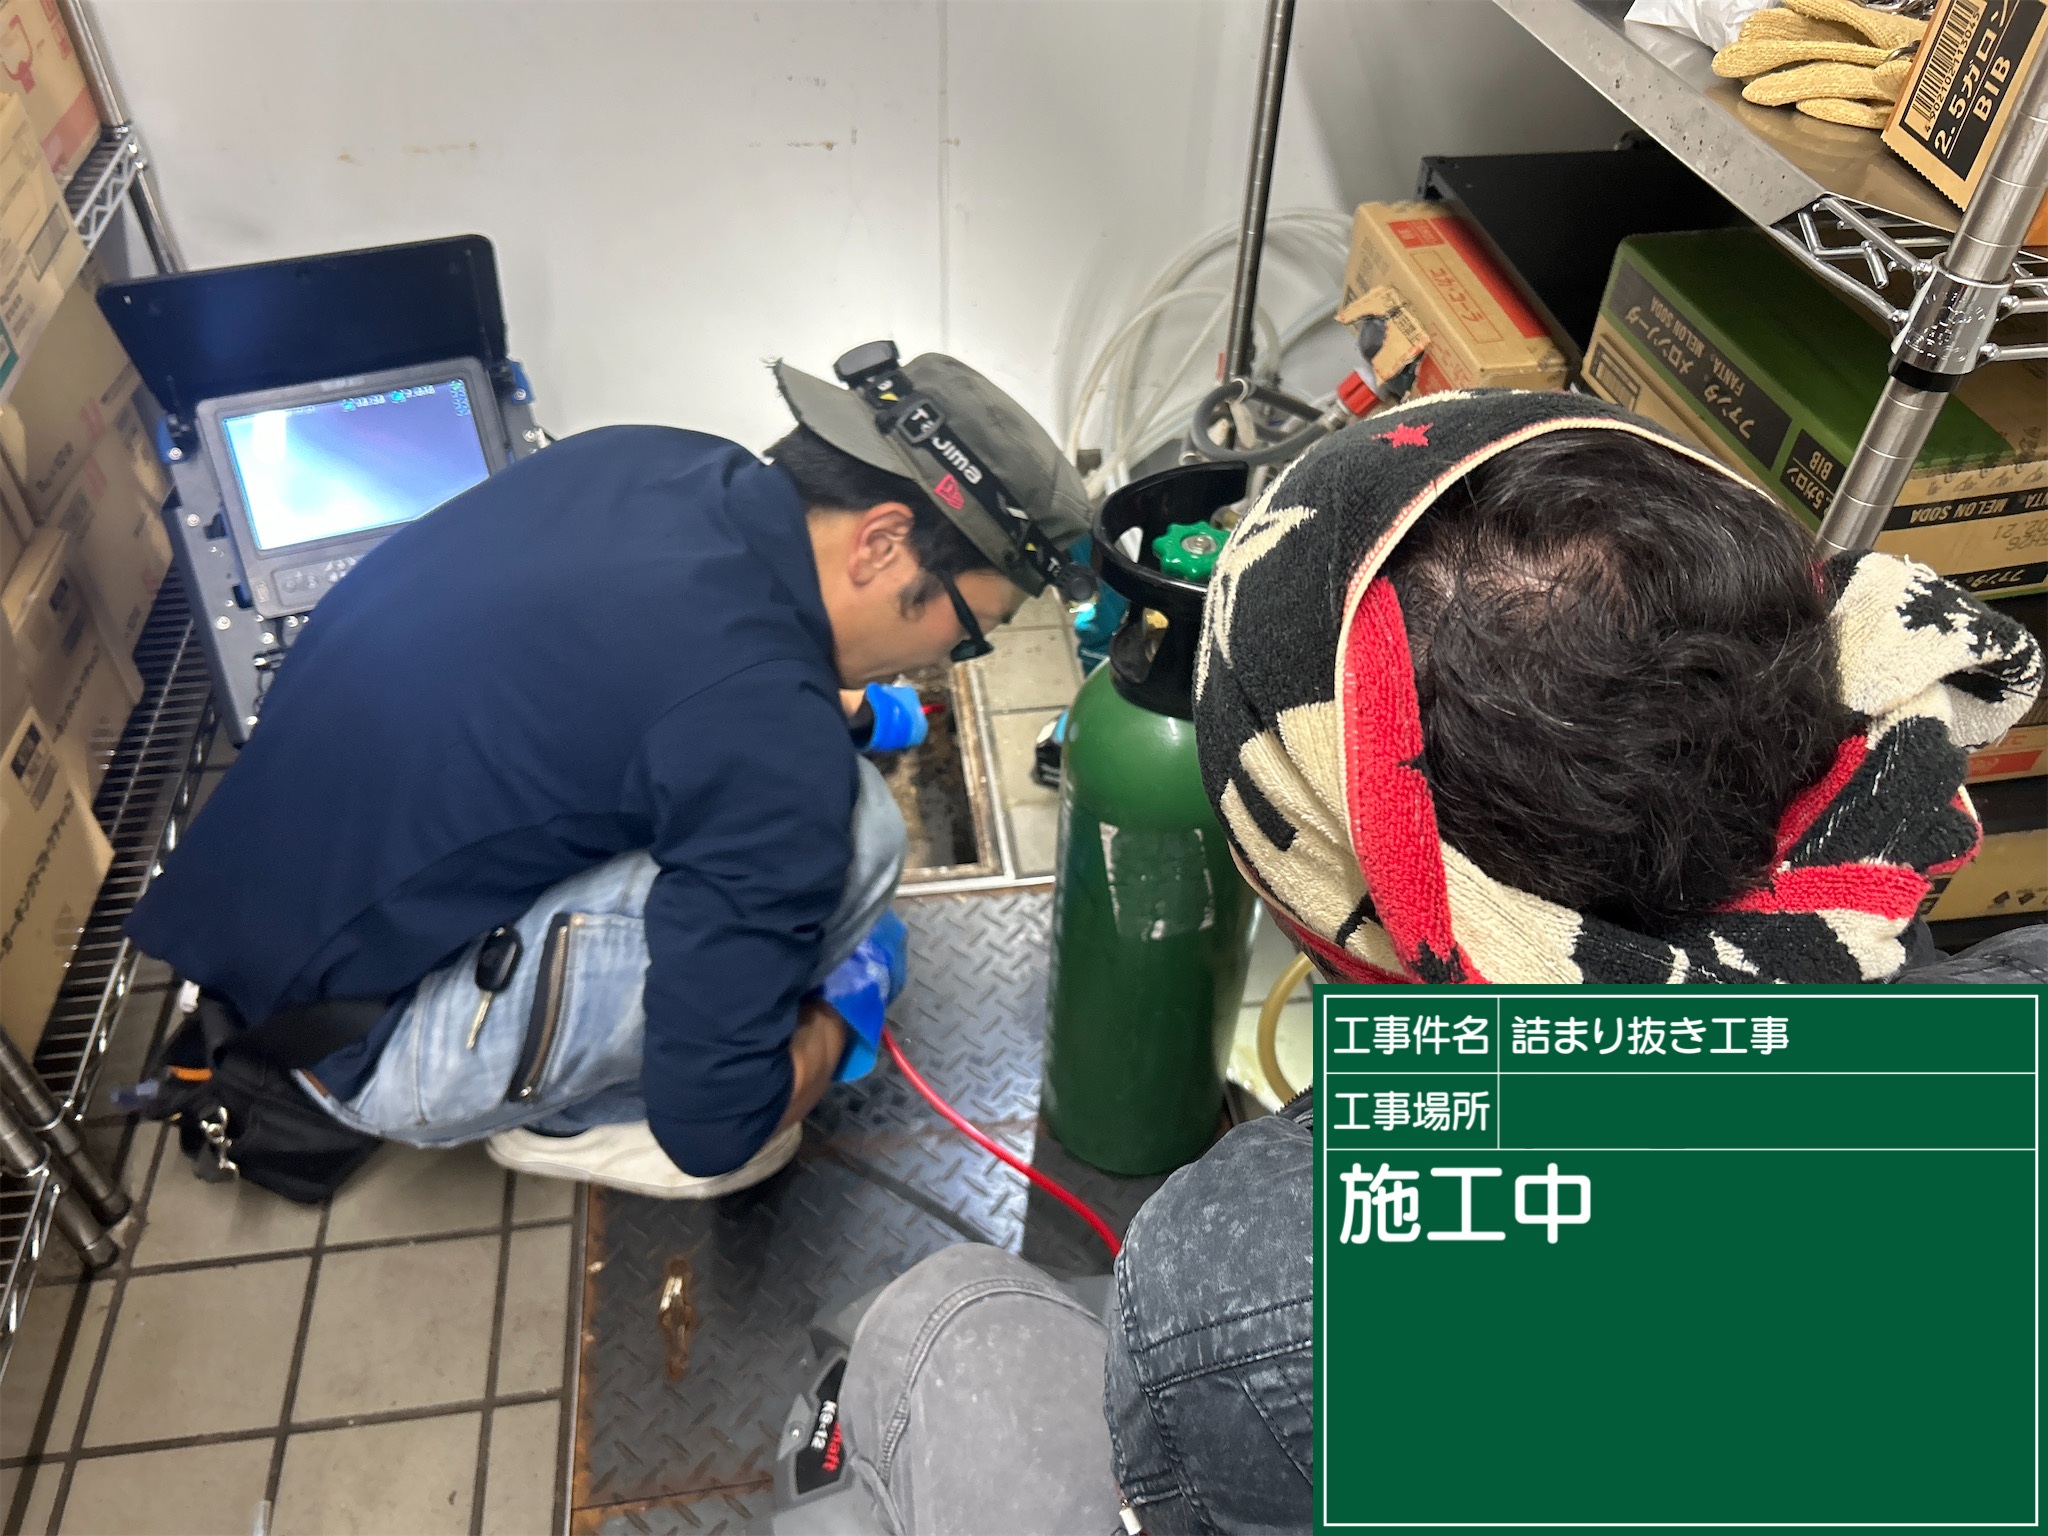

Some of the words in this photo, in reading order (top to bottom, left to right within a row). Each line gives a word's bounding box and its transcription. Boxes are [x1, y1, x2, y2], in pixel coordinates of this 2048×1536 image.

[1972, 56, 2011, 122] BIB
[1651, 296, 1674, 328] SODA
[1625, 306, 1695, 375] メロンソーダ
[1672, 319, 1705, 358] MELON
[1713, 357, 1745, 397] FANTA
[1810, 451, 1833, 480] BIB
[1910, 505, 1949, 524] SODA
[1953, 497, 2009, 518] MELON
